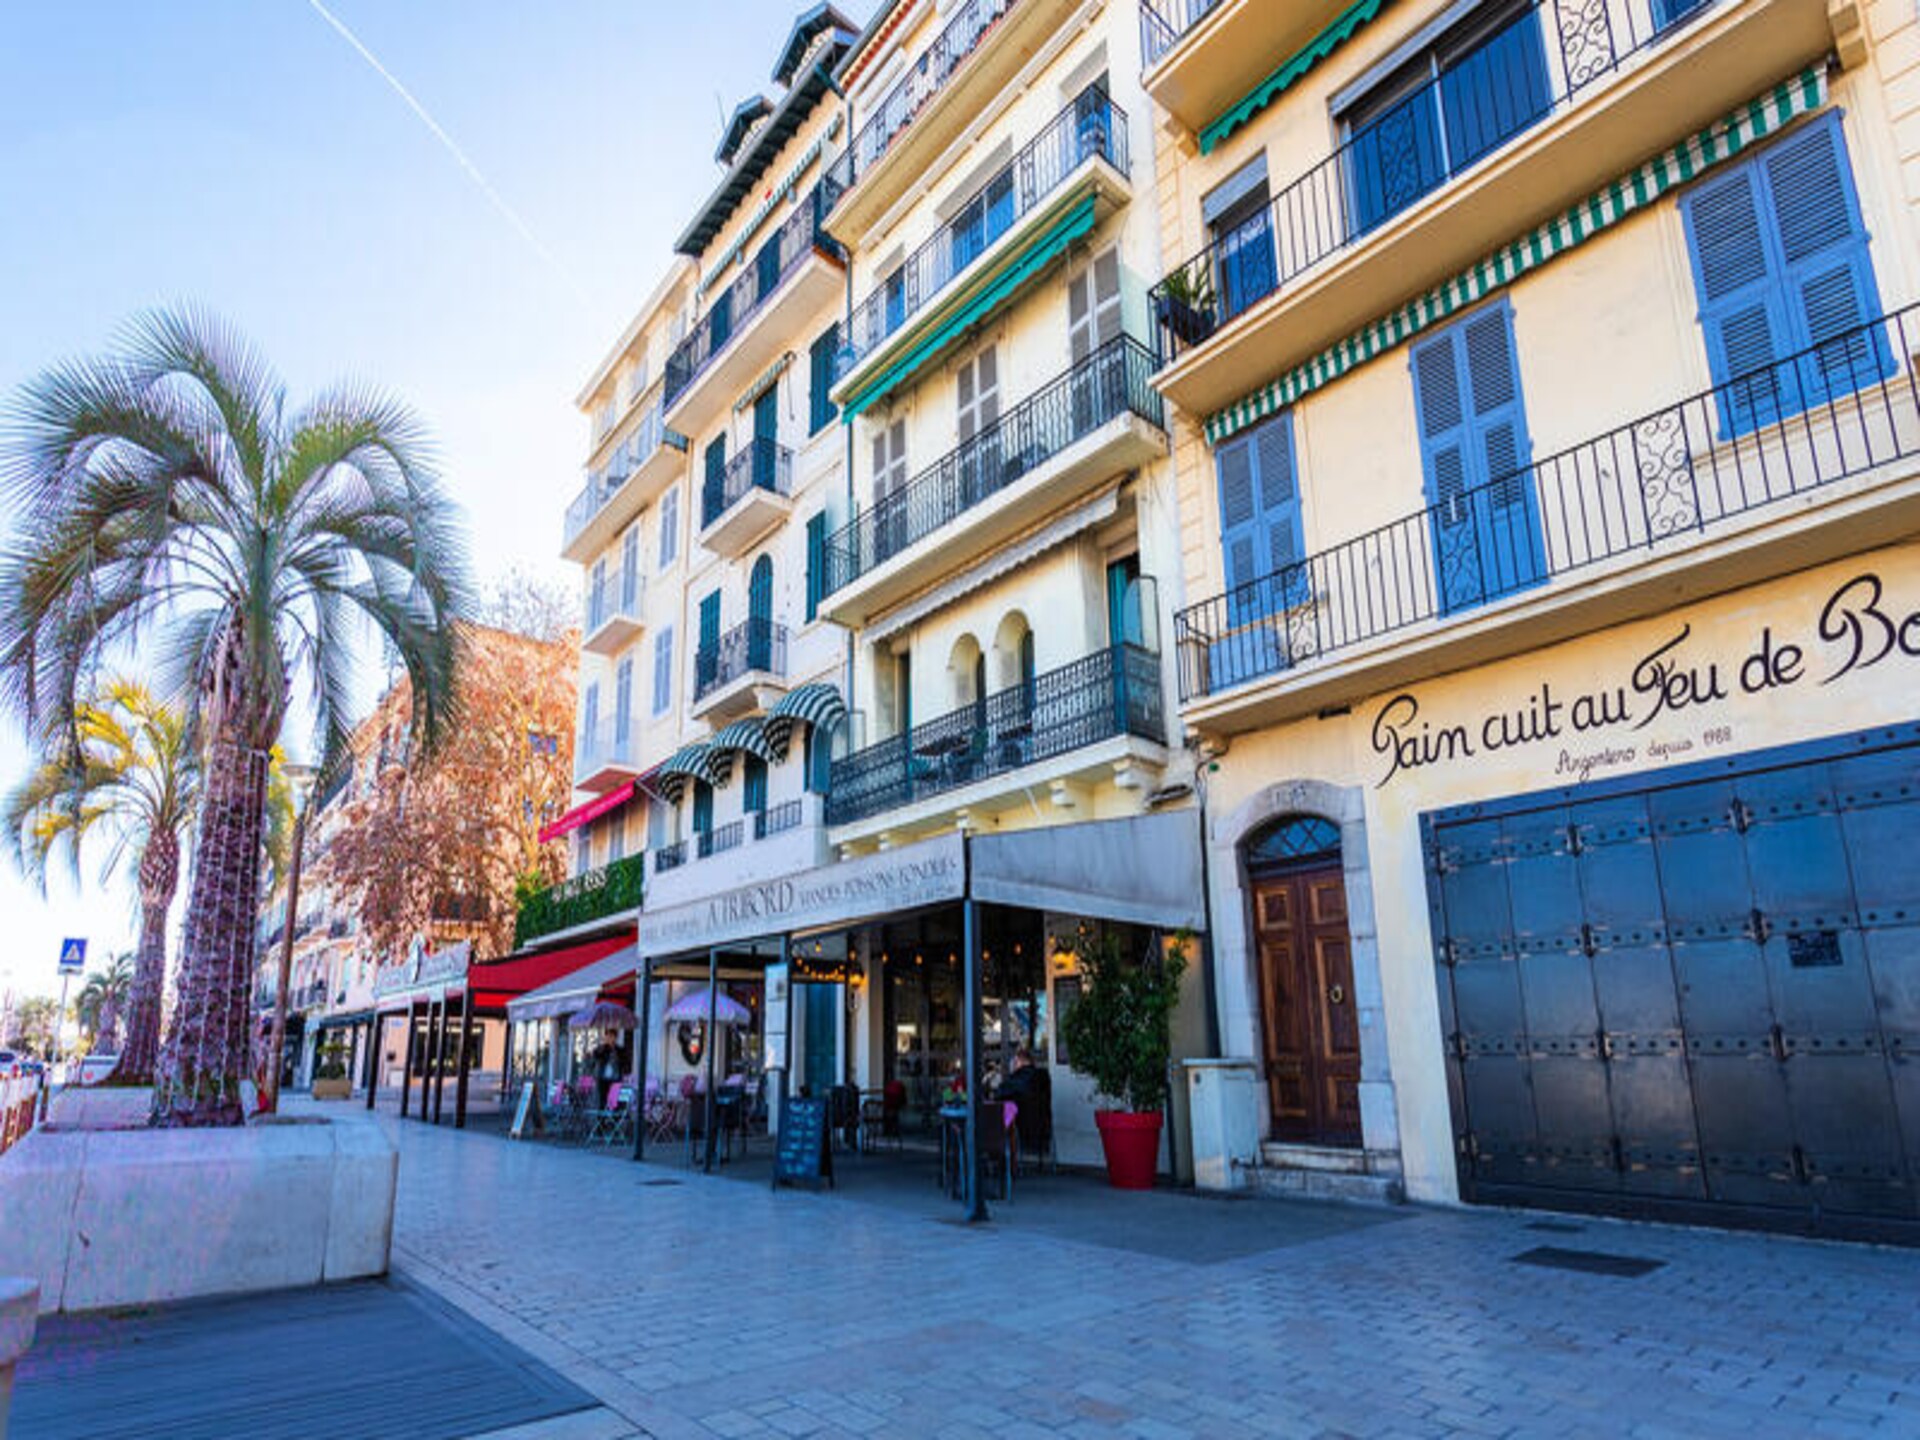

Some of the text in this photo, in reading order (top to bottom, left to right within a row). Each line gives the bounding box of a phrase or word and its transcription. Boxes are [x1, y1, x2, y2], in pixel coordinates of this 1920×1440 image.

[1371, 695, 1475, 789] Pain
[1482, 683, 1563, 751] cuit
[1571, 688, 1630, 731] au
[1631, 623, 1728, 730] Feu
[1740, 627, 1806, 693] de
